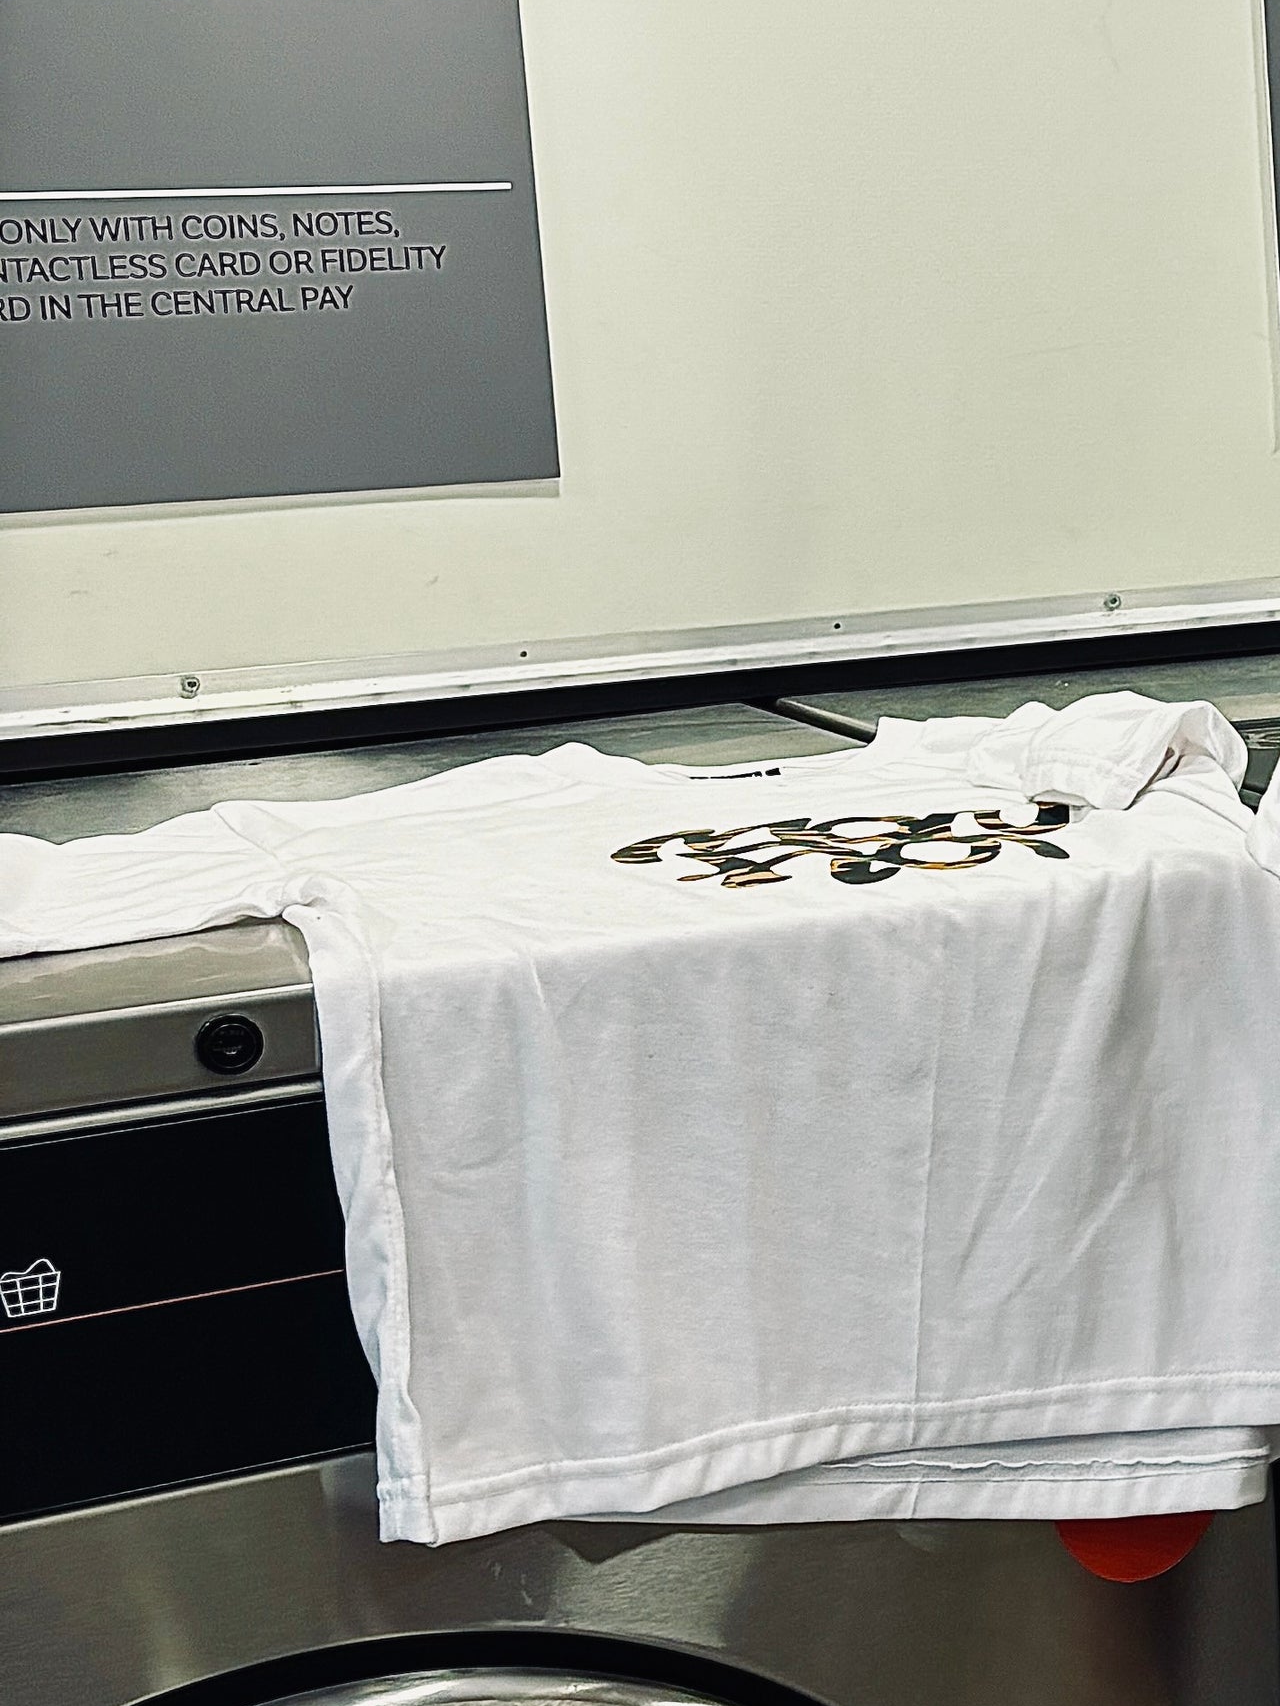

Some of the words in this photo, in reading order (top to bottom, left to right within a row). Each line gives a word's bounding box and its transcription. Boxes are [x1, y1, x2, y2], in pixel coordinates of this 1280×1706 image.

[0, 218, 82, 245] ONLY
[89, 216, 173, 242] WITH
[181, 213, 286, 243] COINS,
[293, 210, 400, 239] NOTES,
[175, 251, 261, 278] CARD
[270, 249, 314, 275] OR
[321, 245, 446, 273] FIDELITY
[40, 294, 72, 321] IN
[77, 292, 144, 319] THE
[151, 288, 295, 316] CENTRAL
[301, 285, 354, 311] PAY
